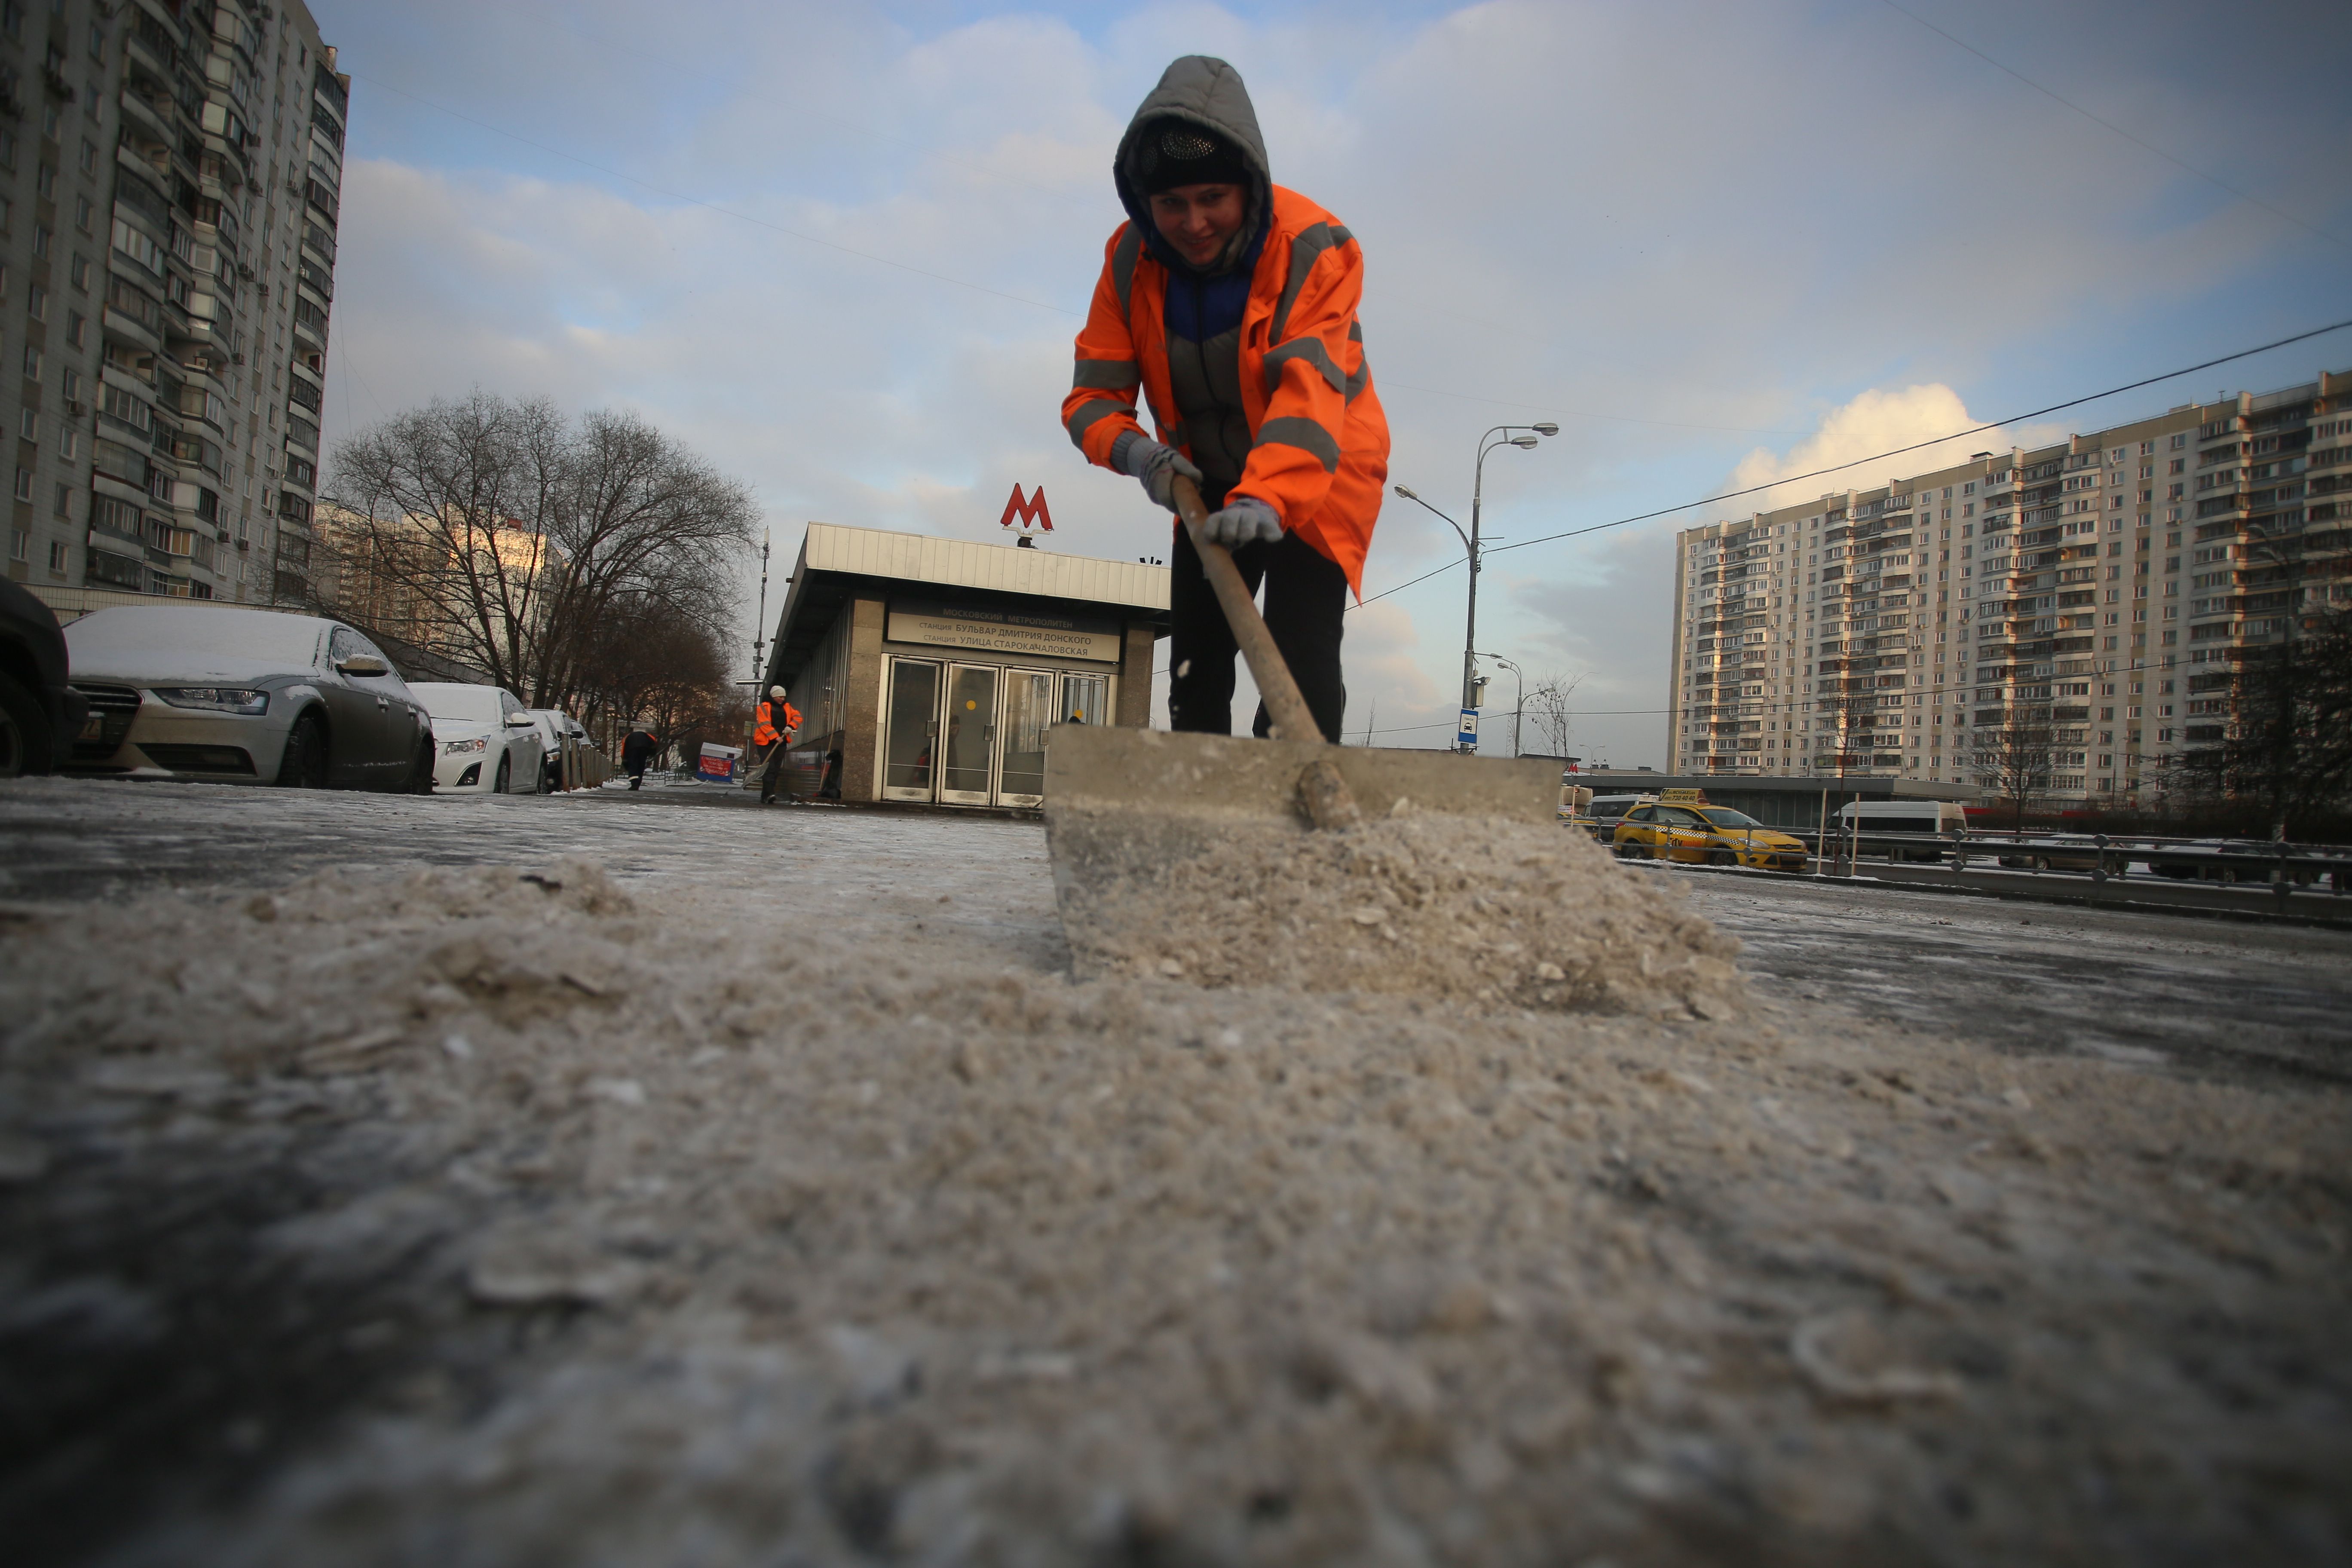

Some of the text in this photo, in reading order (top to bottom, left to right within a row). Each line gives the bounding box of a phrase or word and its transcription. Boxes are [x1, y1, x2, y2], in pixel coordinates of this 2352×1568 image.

[1000, 483, 1053, 528] М
[943, 608, 1072, 628] МОСКОВСКИЙ МЕТРОПОЛИТЕН
[919, 622, 1091, 645] СТАНЦИЯ БУЛЬВАР ДМИТРИЯ ДОНСКОГО
[924, 635, 1087, 655] СТАНЦИЯ УЛИЦА СТАРОКАЧАЛОВСКАЯ
